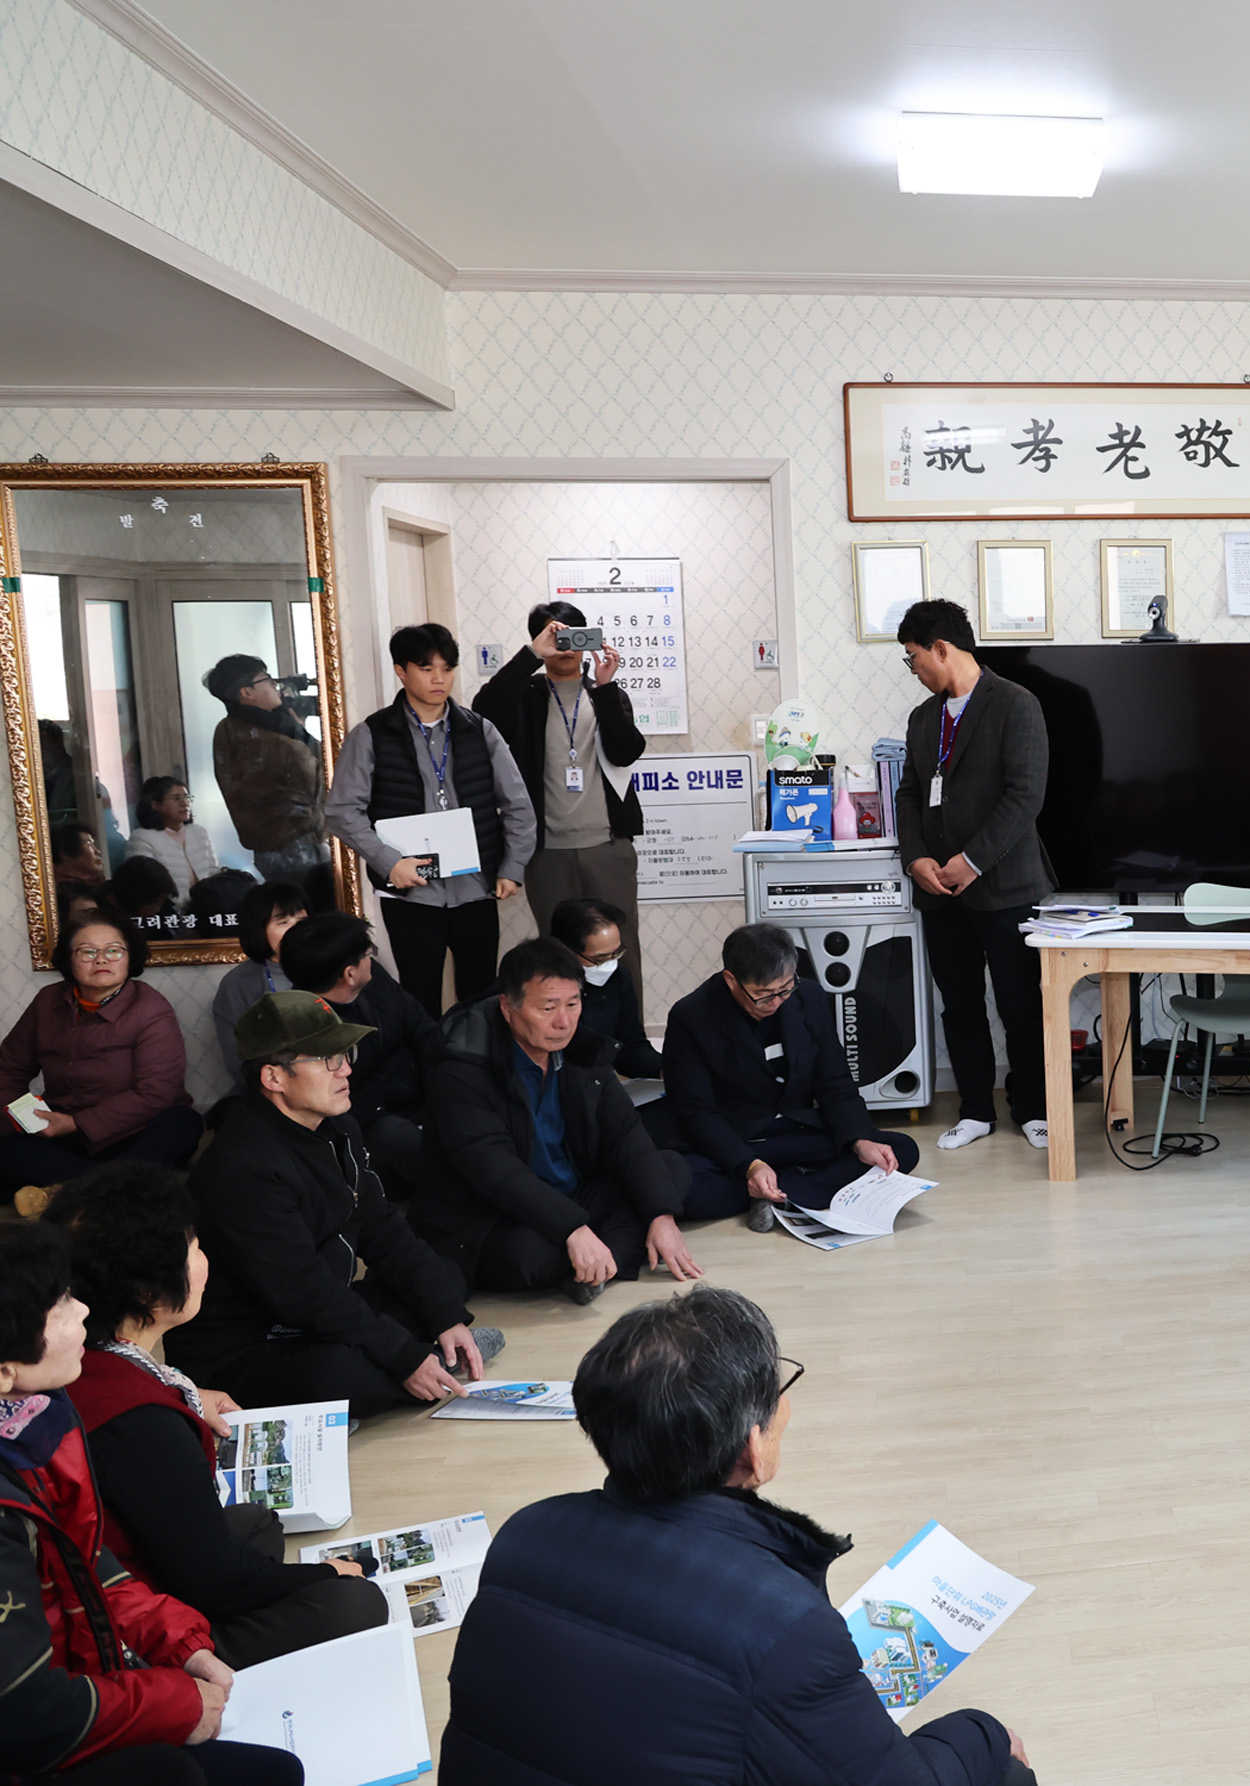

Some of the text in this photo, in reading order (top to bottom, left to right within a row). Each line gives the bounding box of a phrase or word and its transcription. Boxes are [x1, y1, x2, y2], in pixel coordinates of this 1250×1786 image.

[151, 496, 169, 514] 축
[119, 512, 204, 529] 발 전
[609, 567, 622, 585] 2
[663, 594, 669, 605] 1
[597, 614, 671, 626] 4 5 6 7 8
[612, 636, 625, 648] 12
[629, 636, 642, 647] 13
[645, 636, 658, 647] 14
[662, 635, 675, 647] 15
[629, 657, 643, 668] 20
[646, 656, 659, 667] 21
[662, 656, 676, 668] 22
[630, 678, 644, 689] 27
[647, 677, 661, 688] 28
[686, 769, 744, 791] 안내문
[778, 776, 813, 785] smato
[208, 913, 240, 928] 대표
[844, 996, 858, 1042] SOUND
[931, 1575, 963, 1601] 마을단위
[981, 1591, 1008, 1610] 2025년
[930, 1594, 986, 1632] 구축사업 설명자료
